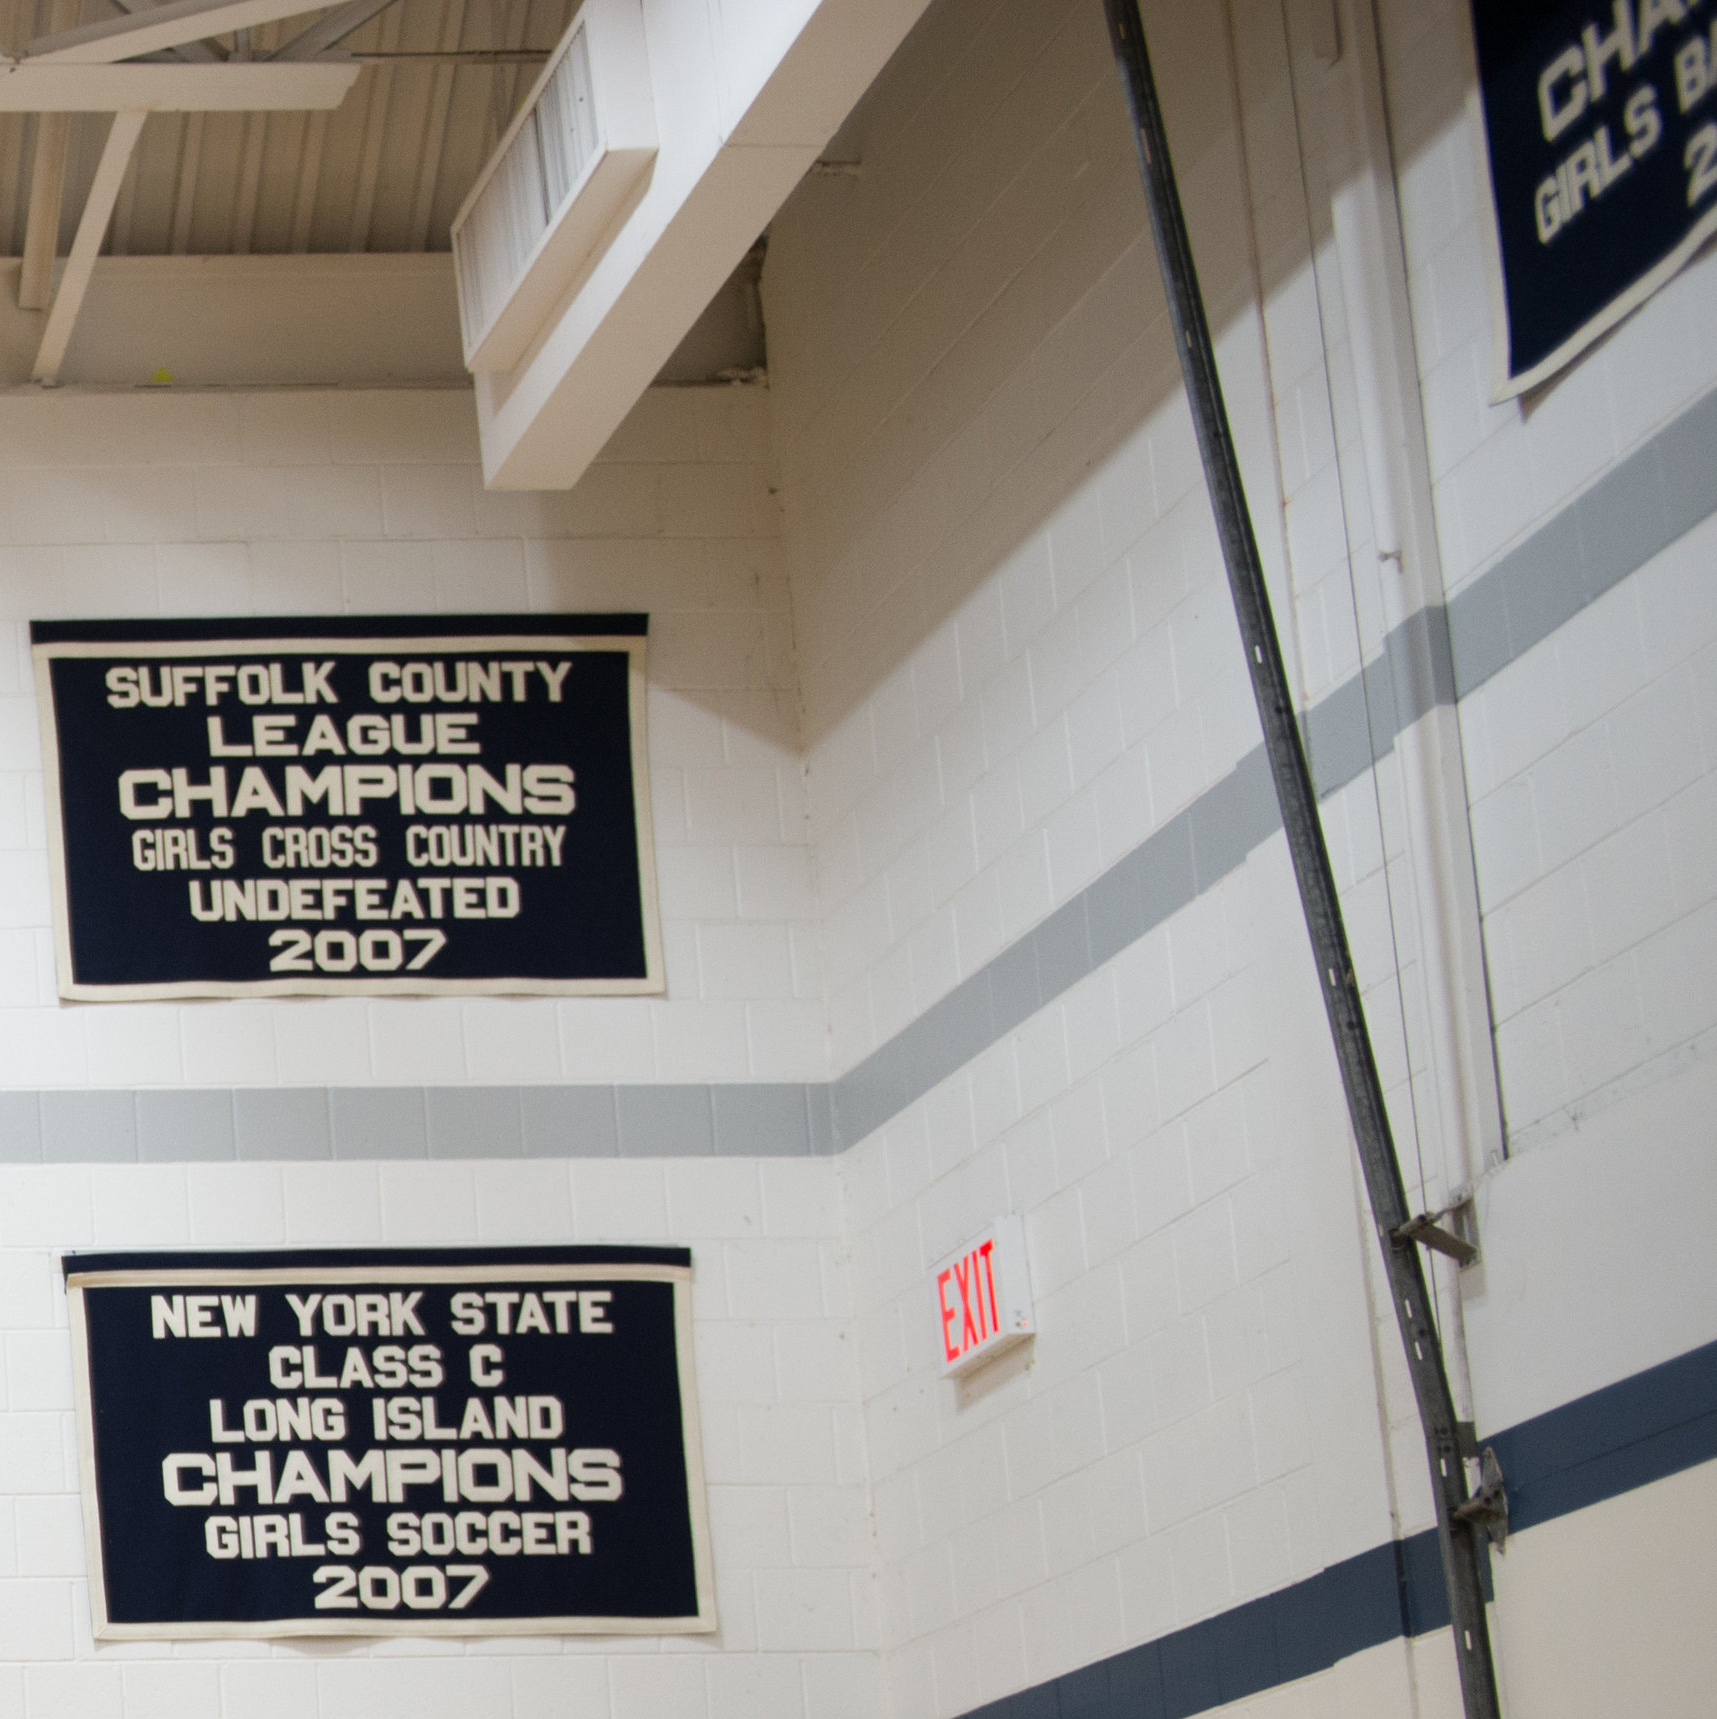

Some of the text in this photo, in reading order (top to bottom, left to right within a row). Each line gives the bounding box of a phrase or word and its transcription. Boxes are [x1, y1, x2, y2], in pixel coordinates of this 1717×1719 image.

[1538, 0, 1699, 142] CHA
[1534, 20, 1717, 246] GIRLS B
[106, 662, 571, 708] SUFFOLK COUNTY
[207, 714, 480, 756] LEAGUE
[119, 764, 575, 819] CHAMPIONS
[132, 825, 565, 870] GIRLS CROSS COUNTRY
[189, 877, 519, 921] UNDEFEATED
[269, 929, 446, 971] 2007
[151, 1291, 612, 1338] NEW YORK STATE
[937, 1238, 1000, 1363] EXIT
[269, 1344, 503, 1388] CLASS C
[210, 1396, 563, 1442] LONG ISLAND
[162, 1448, 622, 1506] CHAMPIONS
[205, 1511, 591, 1558] GIRLS SOCCER
[313, 1565, 489, 1609] 2007
